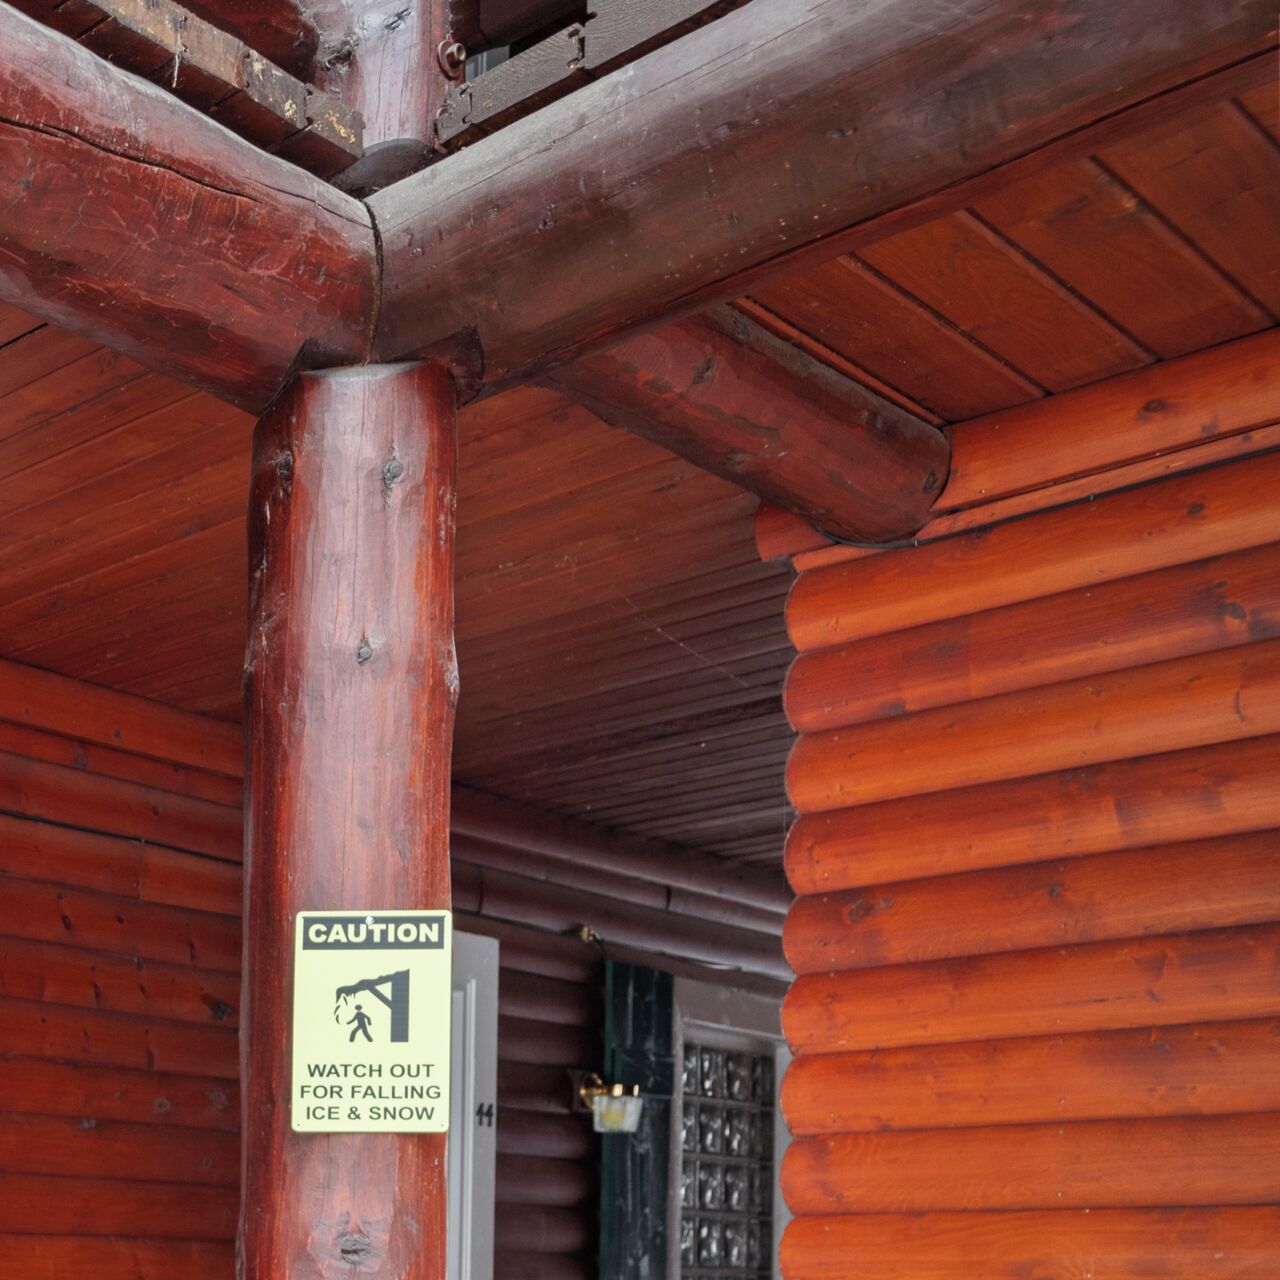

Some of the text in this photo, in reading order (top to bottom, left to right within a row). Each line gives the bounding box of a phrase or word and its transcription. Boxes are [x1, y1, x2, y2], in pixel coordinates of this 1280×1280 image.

[308, 923, 439, 944] CAUTION
[307, 1064, 435, 1078] WATCH OUT
[300, 1085, 441, 1099] FOR FALLING
[306, 1106, 435, 1120] ICE & SNOW
[476, 1102, 494, 1128] 44
